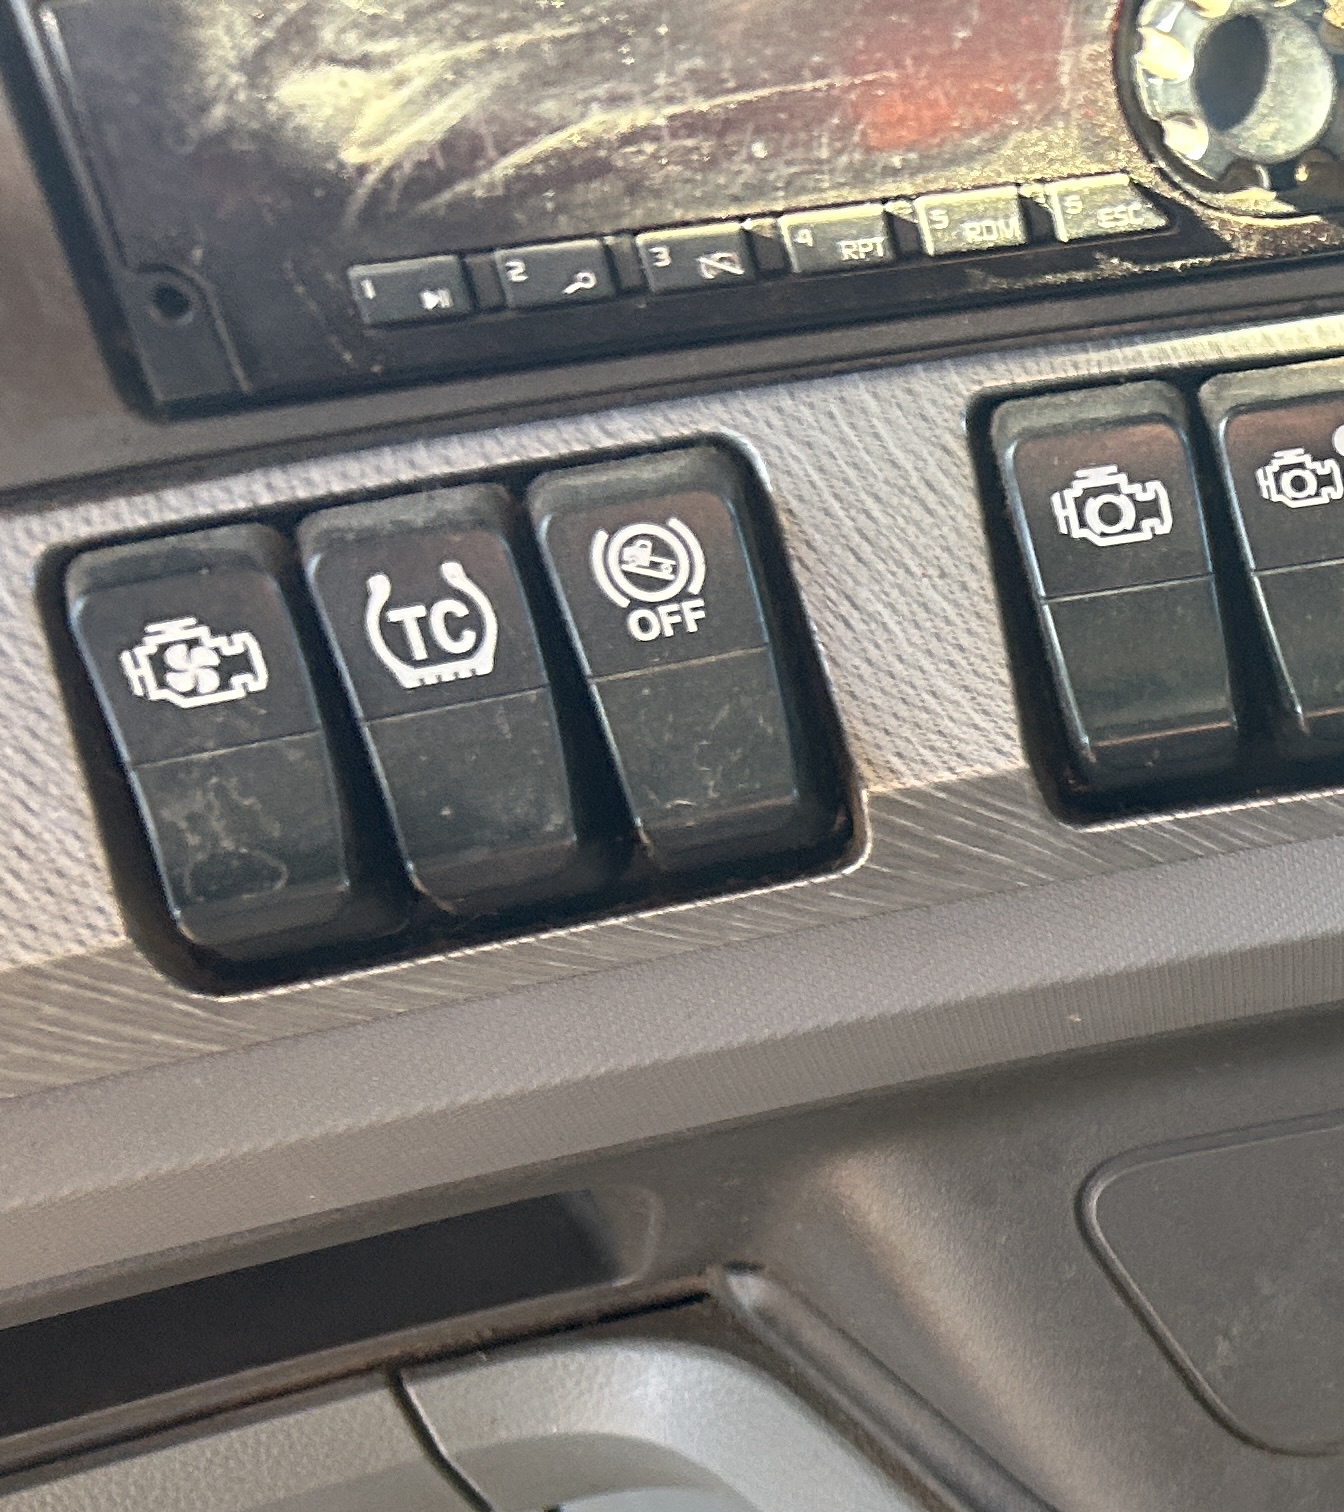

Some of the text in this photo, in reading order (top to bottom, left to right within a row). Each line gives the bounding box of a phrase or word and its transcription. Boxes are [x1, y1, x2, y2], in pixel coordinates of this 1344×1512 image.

[1097, 203, 1144, 228] ESC
[965, 217, 1019, 246] RDM
[650, 246, 671, 267] 3
[840, 237, 886, 262] RPT
[506, 260, 528, 283] 2
[360, 279, 376, 299] 1
[387, 599, 477, 660] TC
[627, 599, 706, 641] OFF
